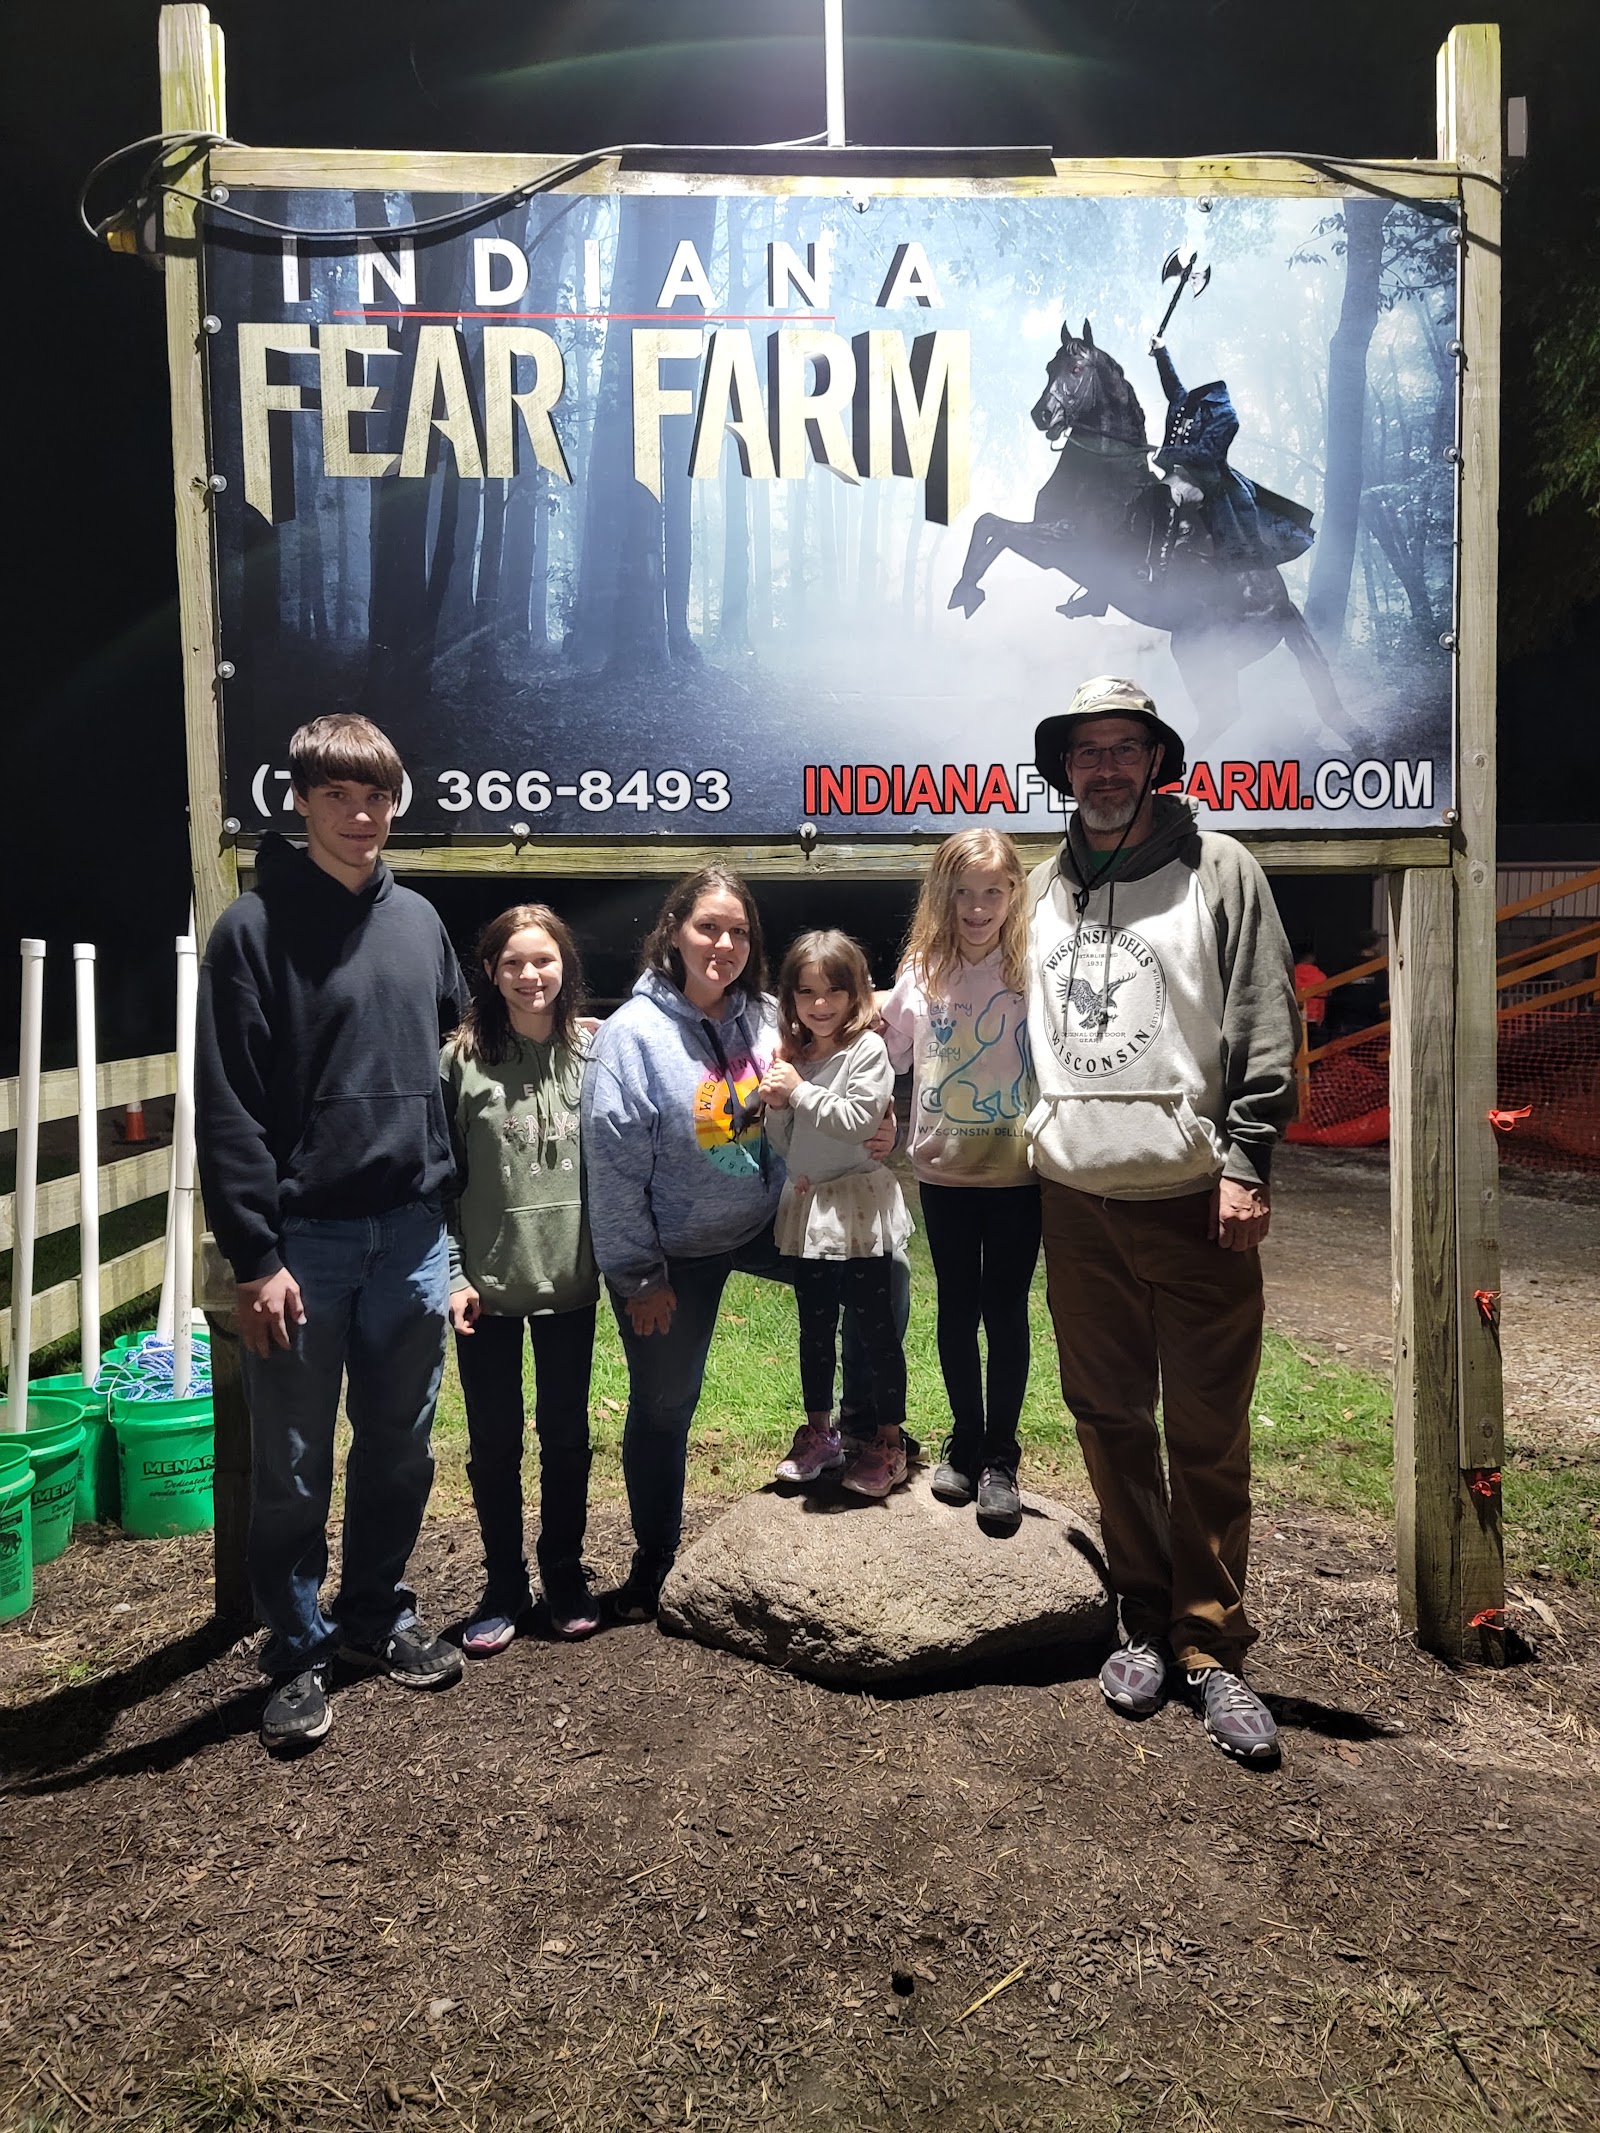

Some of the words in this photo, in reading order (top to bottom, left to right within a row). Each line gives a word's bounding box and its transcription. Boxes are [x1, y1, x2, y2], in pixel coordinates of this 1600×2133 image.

[281, 231, 945, 309] INDIANA
[237, 322, 574, 526] FEAR
[631, 327, 973, 528] FARM
[252, 763, 413, 818] (7)
[436, 768, 732, 814] 366-8493
[1046, 930, 1118, 971] WISCONSIN
[1119, 932, 1154, 969] DELLS
[954, 1002, 973, 1017] my
[1051, 1028, 1151, 1074] WISCONSIN
